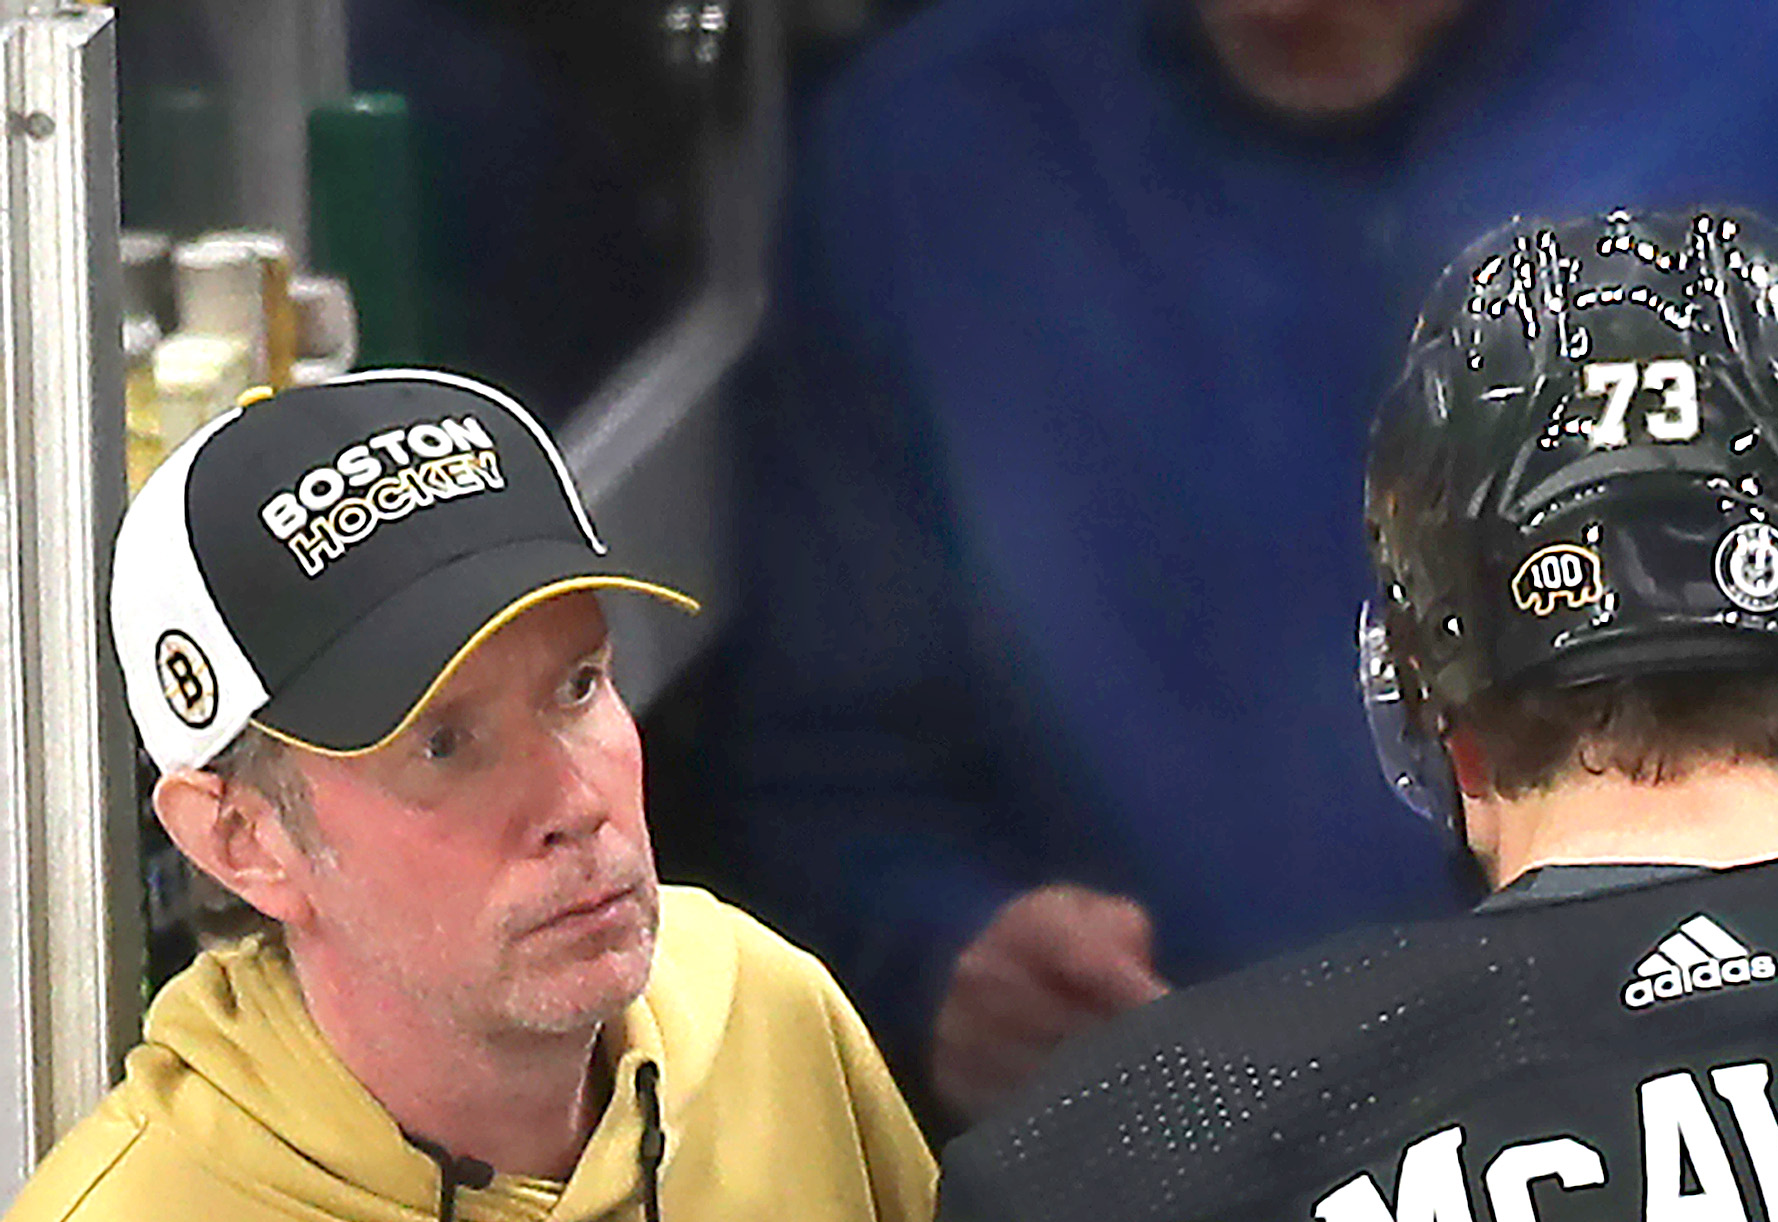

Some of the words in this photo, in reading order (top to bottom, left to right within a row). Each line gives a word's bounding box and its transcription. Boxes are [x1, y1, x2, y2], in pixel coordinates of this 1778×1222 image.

[1583, 359, 1699, 447] 73
[261, 416, 494, 540] BOSTON
[287, 450, 506, 577] HOCKEY
[1530, 552, 1583, 590] 100
[1623, 953, 1777, 1009] adidas
